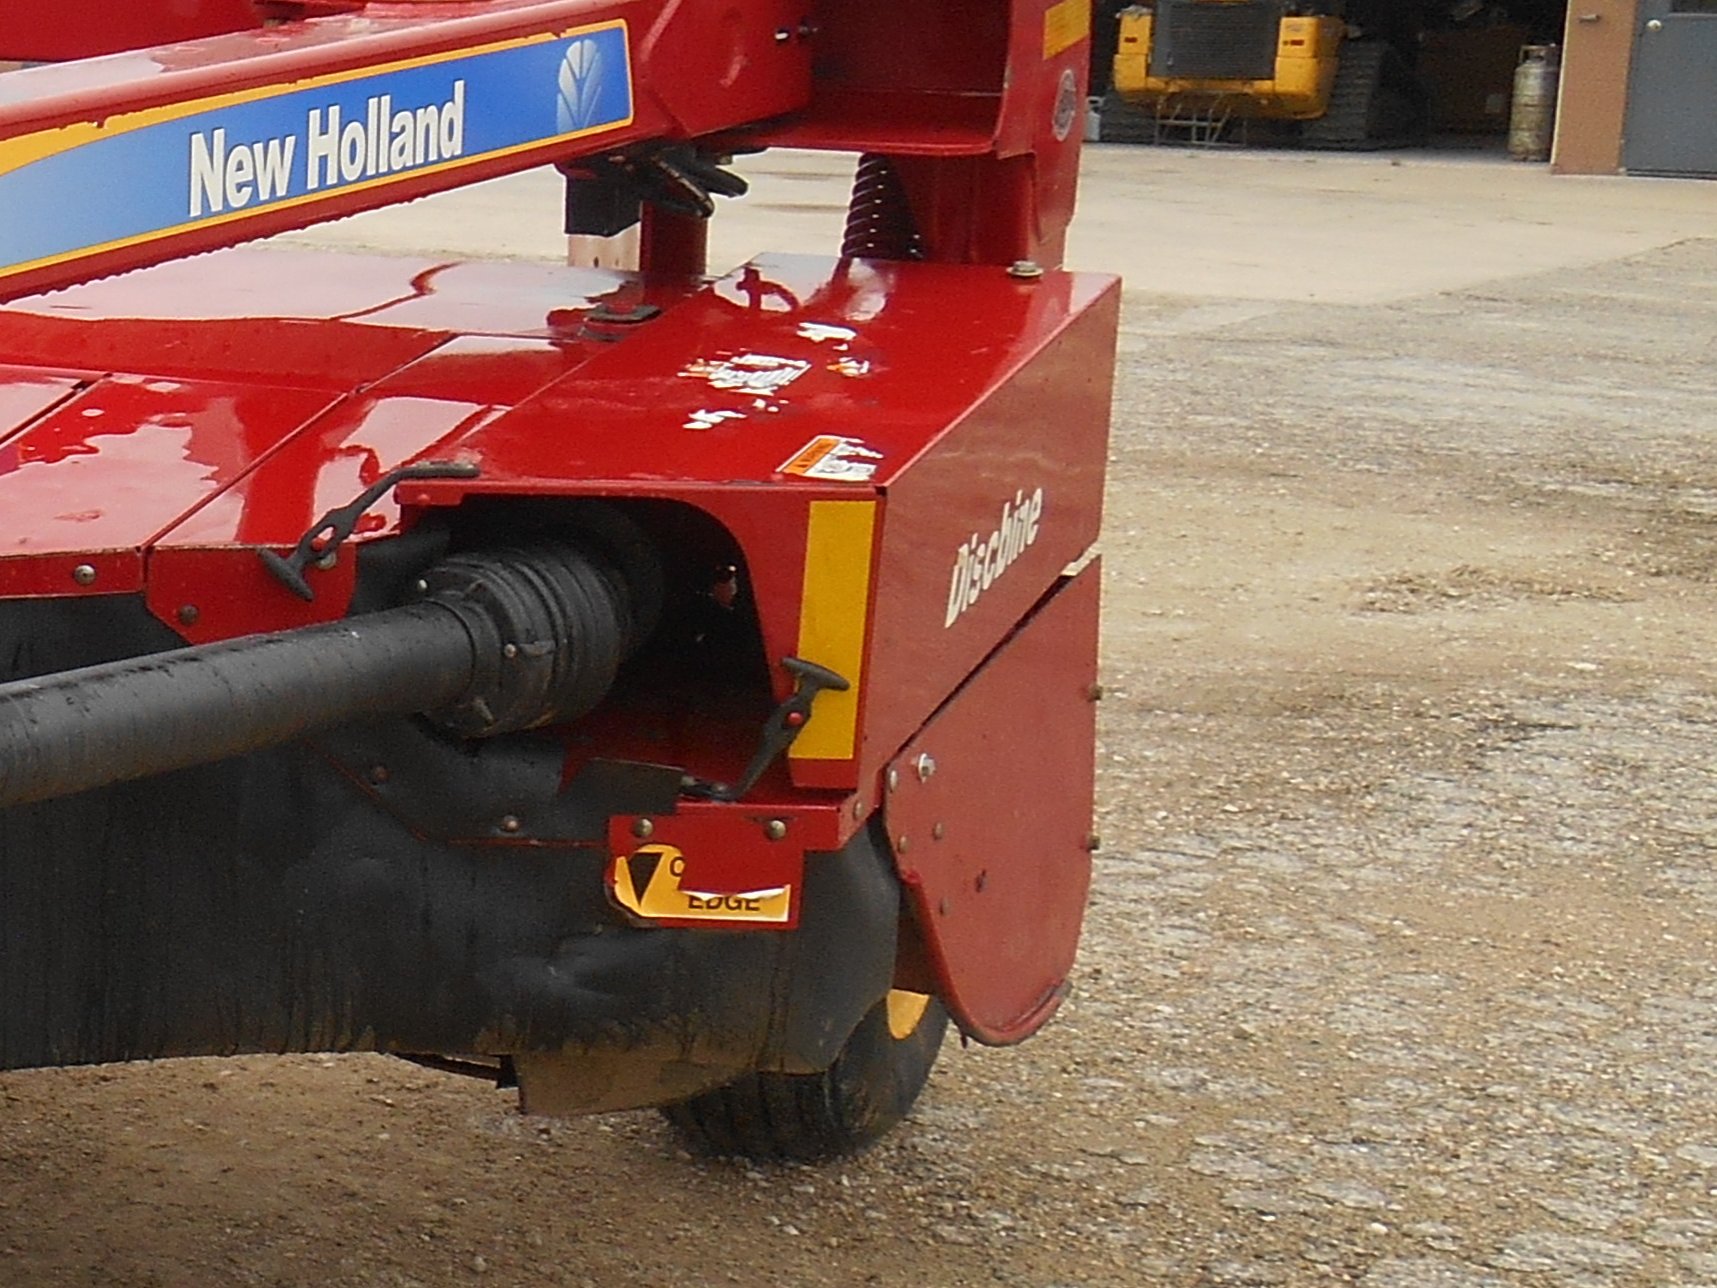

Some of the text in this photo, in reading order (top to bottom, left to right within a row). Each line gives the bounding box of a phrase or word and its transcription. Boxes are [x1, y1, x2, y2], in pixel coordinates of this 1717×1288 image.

[186, 78, 465, 218] New Holland
[943, 487, 1043, 629] Discbine
